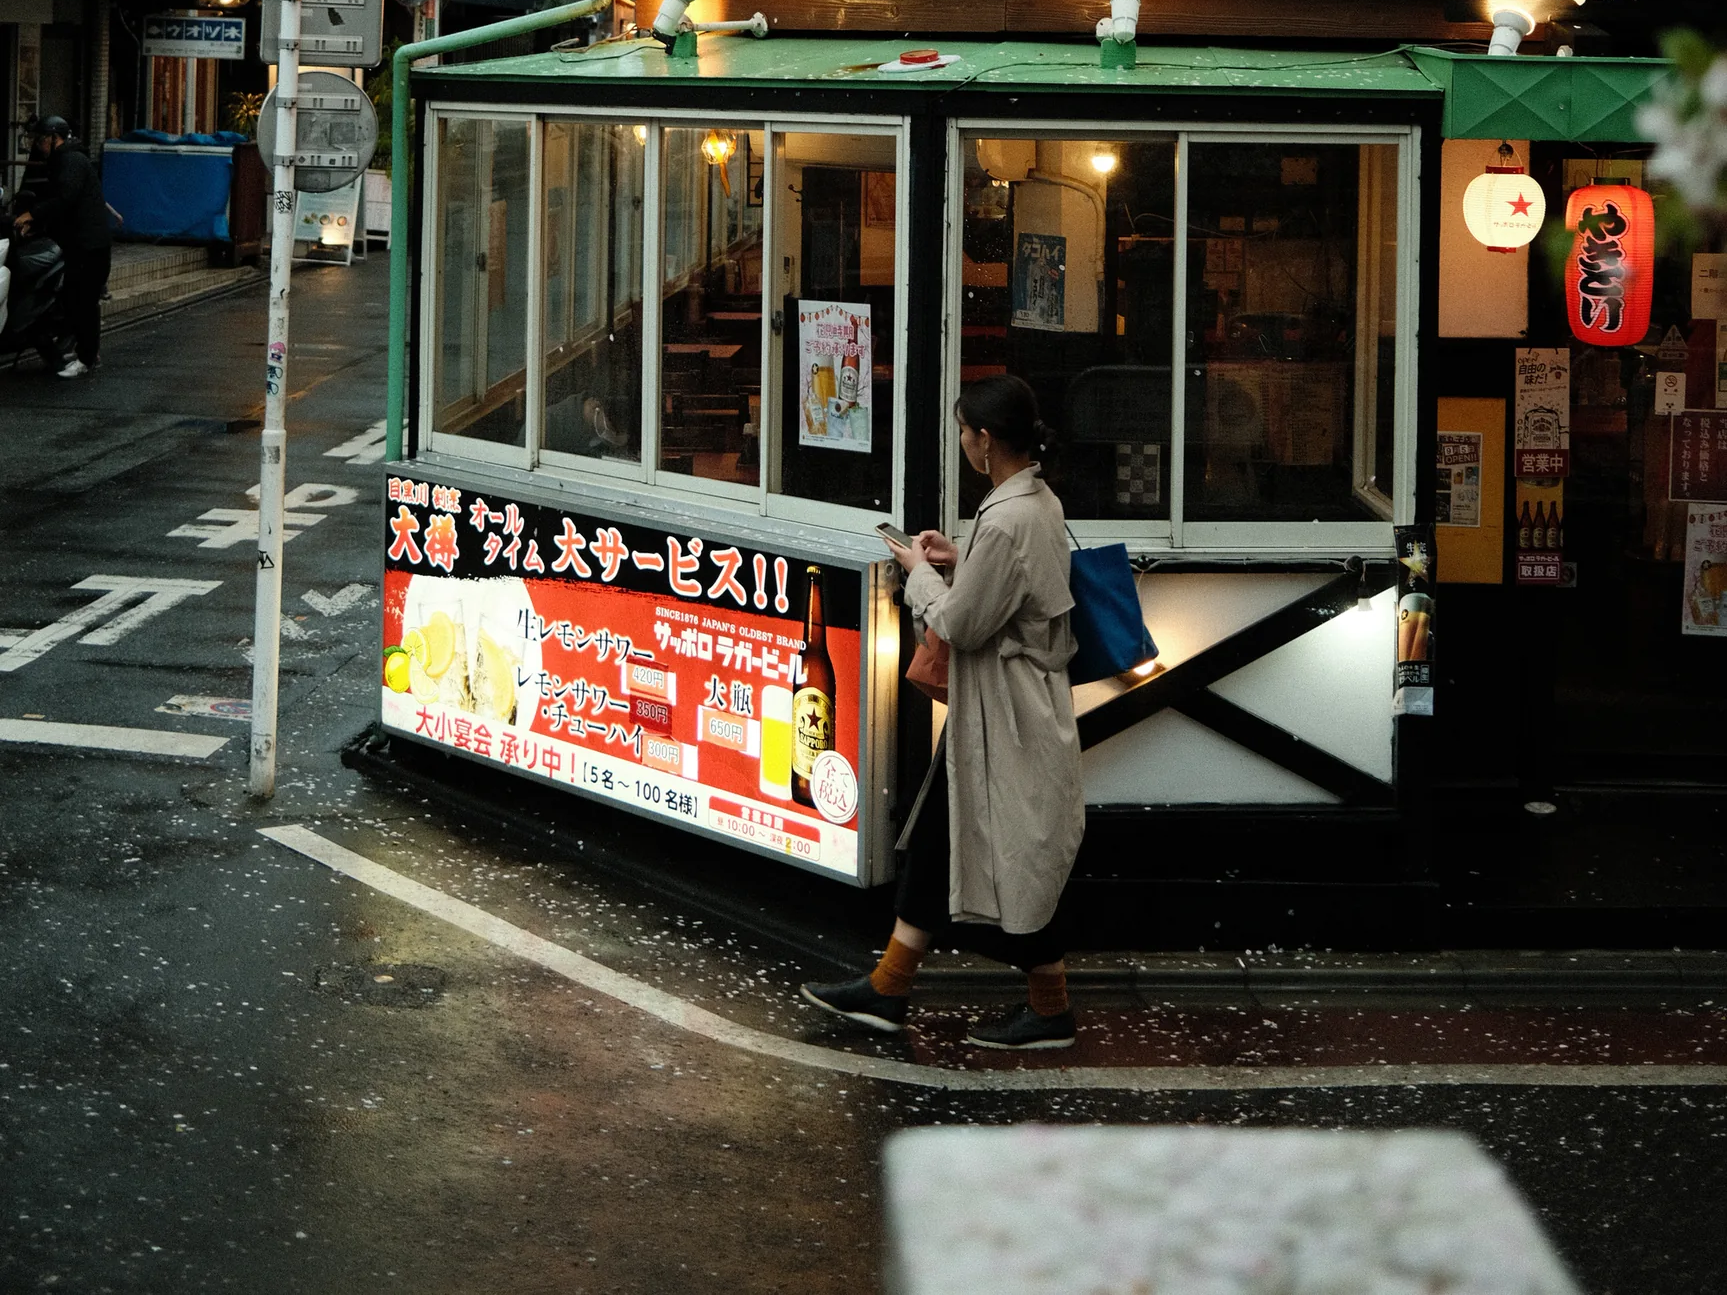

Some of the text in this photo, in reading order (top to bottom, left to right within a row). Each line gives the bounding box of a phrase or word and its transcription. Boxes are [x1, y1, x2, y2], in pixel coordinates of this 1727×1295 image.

[1577, 199, 1630, 333] やきとり
[804, 340, 866, 359] ご予約承ります
[1518, 362, 1546, 376] 自由の
[1521, 453, 1564, 473] 営業中
[388, 477, 430, 508] 目黒川
[469, 497, 525, 536] オール
[388, 504, 460, 573] 大樽
[483, 531, 545, 574] タイム
[551, 516, 789, 614] 大サービス!!
[1520, 564, 1558, 577] 取扱店
[516, 607, 653, 663] 生レモンサワー
[702, 617, 736, 635] JAPAN'S
[739, 627, 774, 643] OLDEST
[776, 635, 807, 651] BRAND
[653, 620, 808, 685] サッポロ ラガービール
[516, 666, 630, 713] レモンサワー
[633, 666, 664, 688] 420円
[636, 700, 669, 723] 350円
[704, 675, 754, 717] 大瓶
[415, 704, 494, 758] 大小宴会
[709, 719, 743, 743] 650円
[799, 735, 829, 750] SAPPORO
[646, 740, 679, 764] 300円
[727, 818, 756, 837] 10:00
